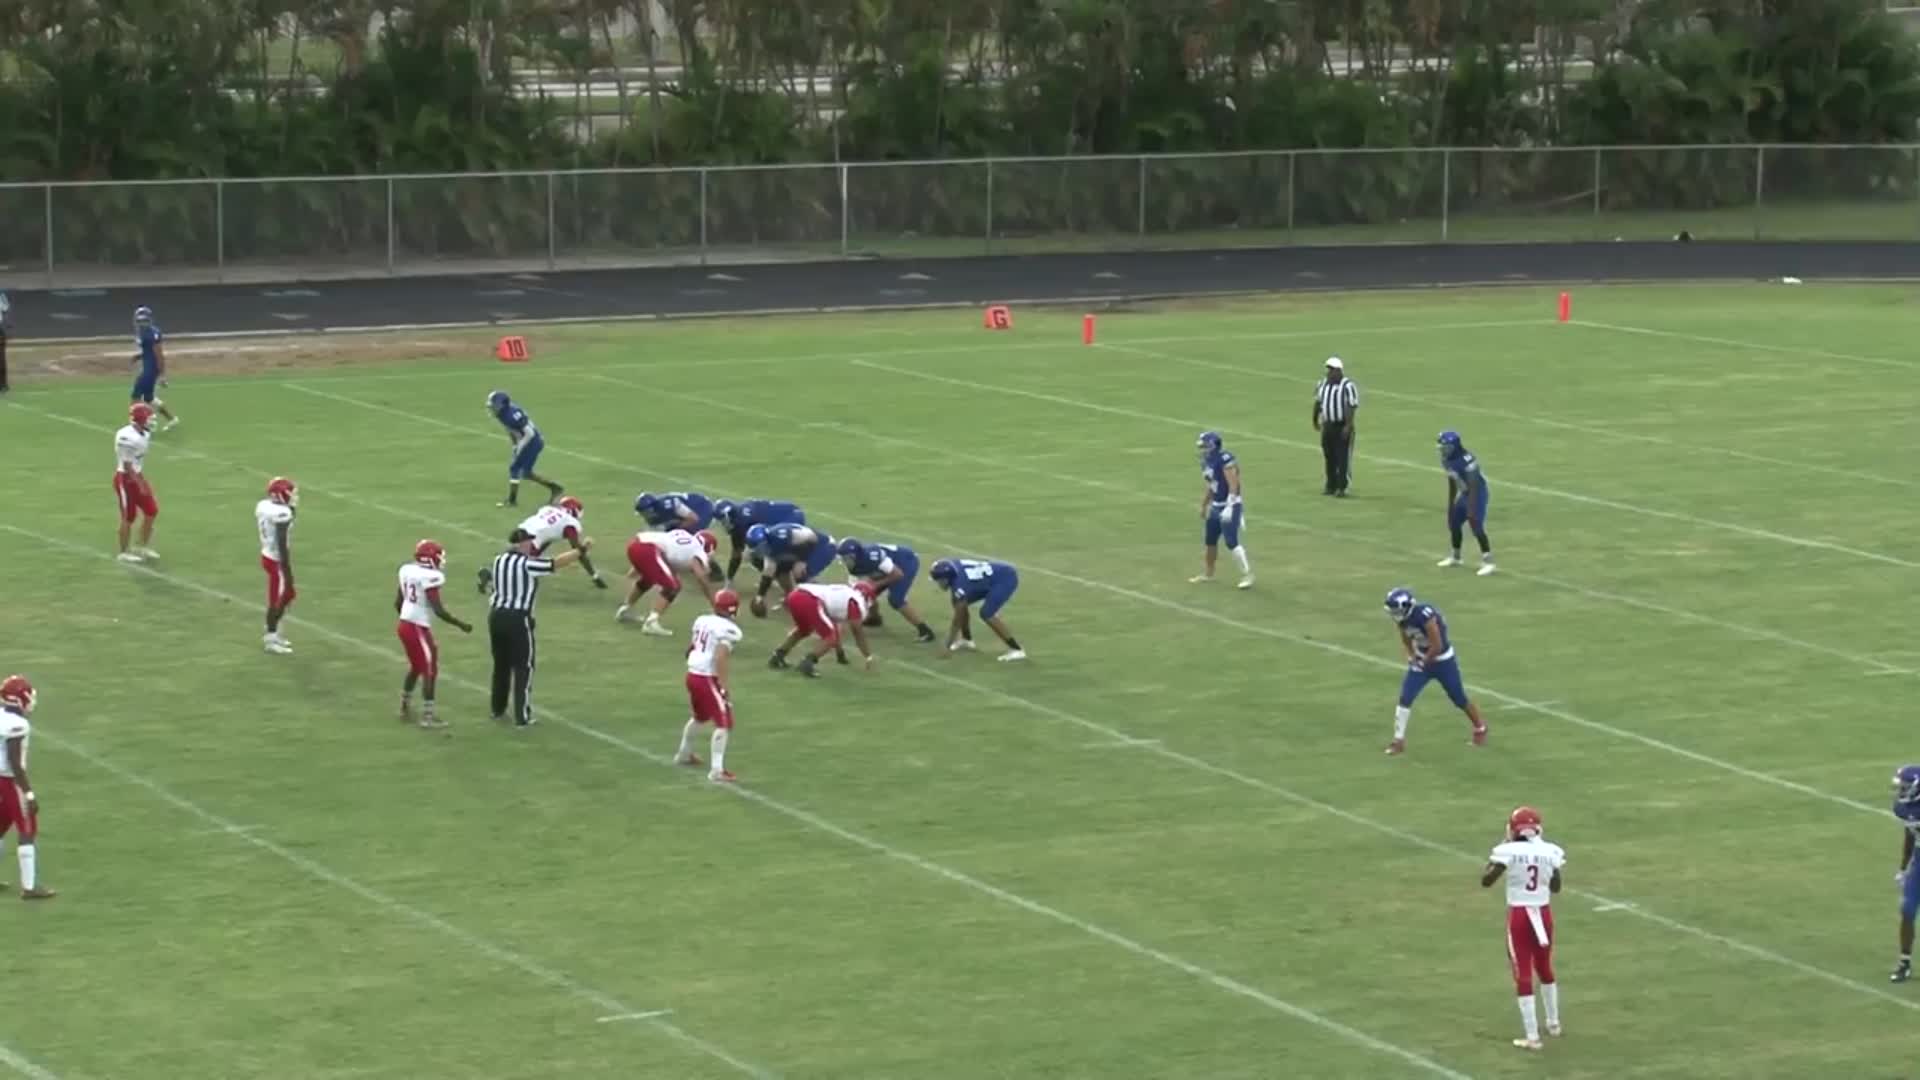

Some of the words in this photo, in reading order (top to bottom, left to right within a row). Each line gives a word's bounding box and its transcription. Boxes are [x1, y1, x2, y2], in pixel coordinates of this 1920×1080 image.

[992, 309, 1008, 328] G
[506, 339, 525, 357] 10
[1526, 865, 1538, 892] 3
